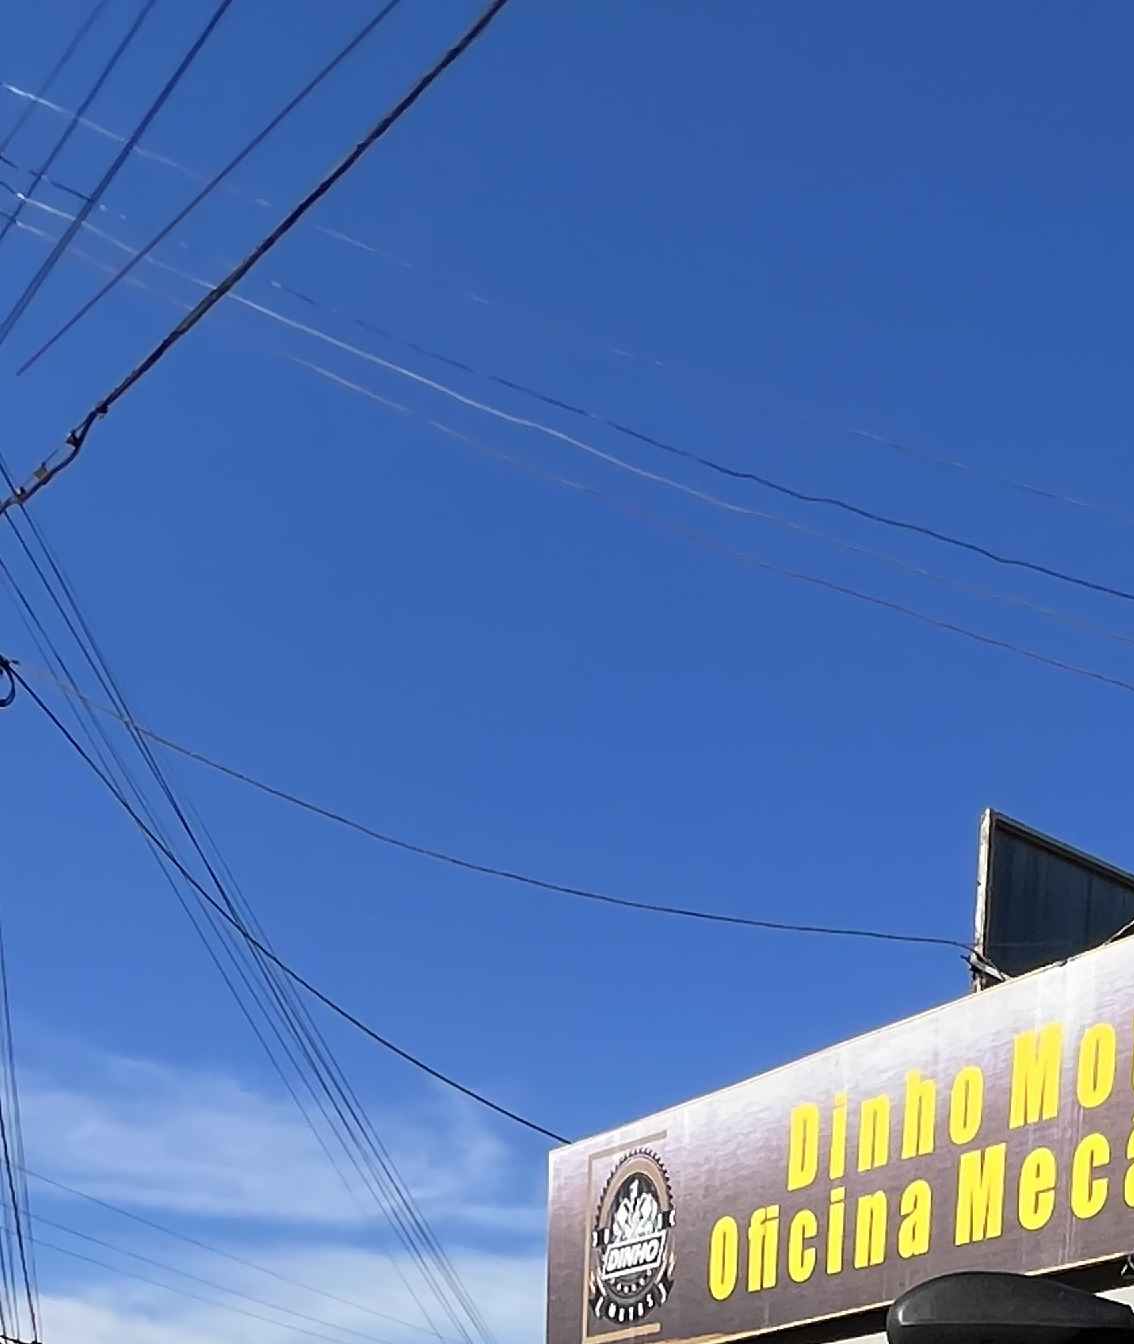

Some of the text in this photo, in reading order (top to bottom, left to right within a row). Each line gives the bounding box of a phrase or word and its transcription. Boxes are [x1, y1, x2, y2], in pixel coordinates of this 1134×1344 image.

[786, 1066, 983, 1193] Dinho
[606, 1238, 660, 1272] DINHO
[708, 1180, 932, 1301] Oficina
